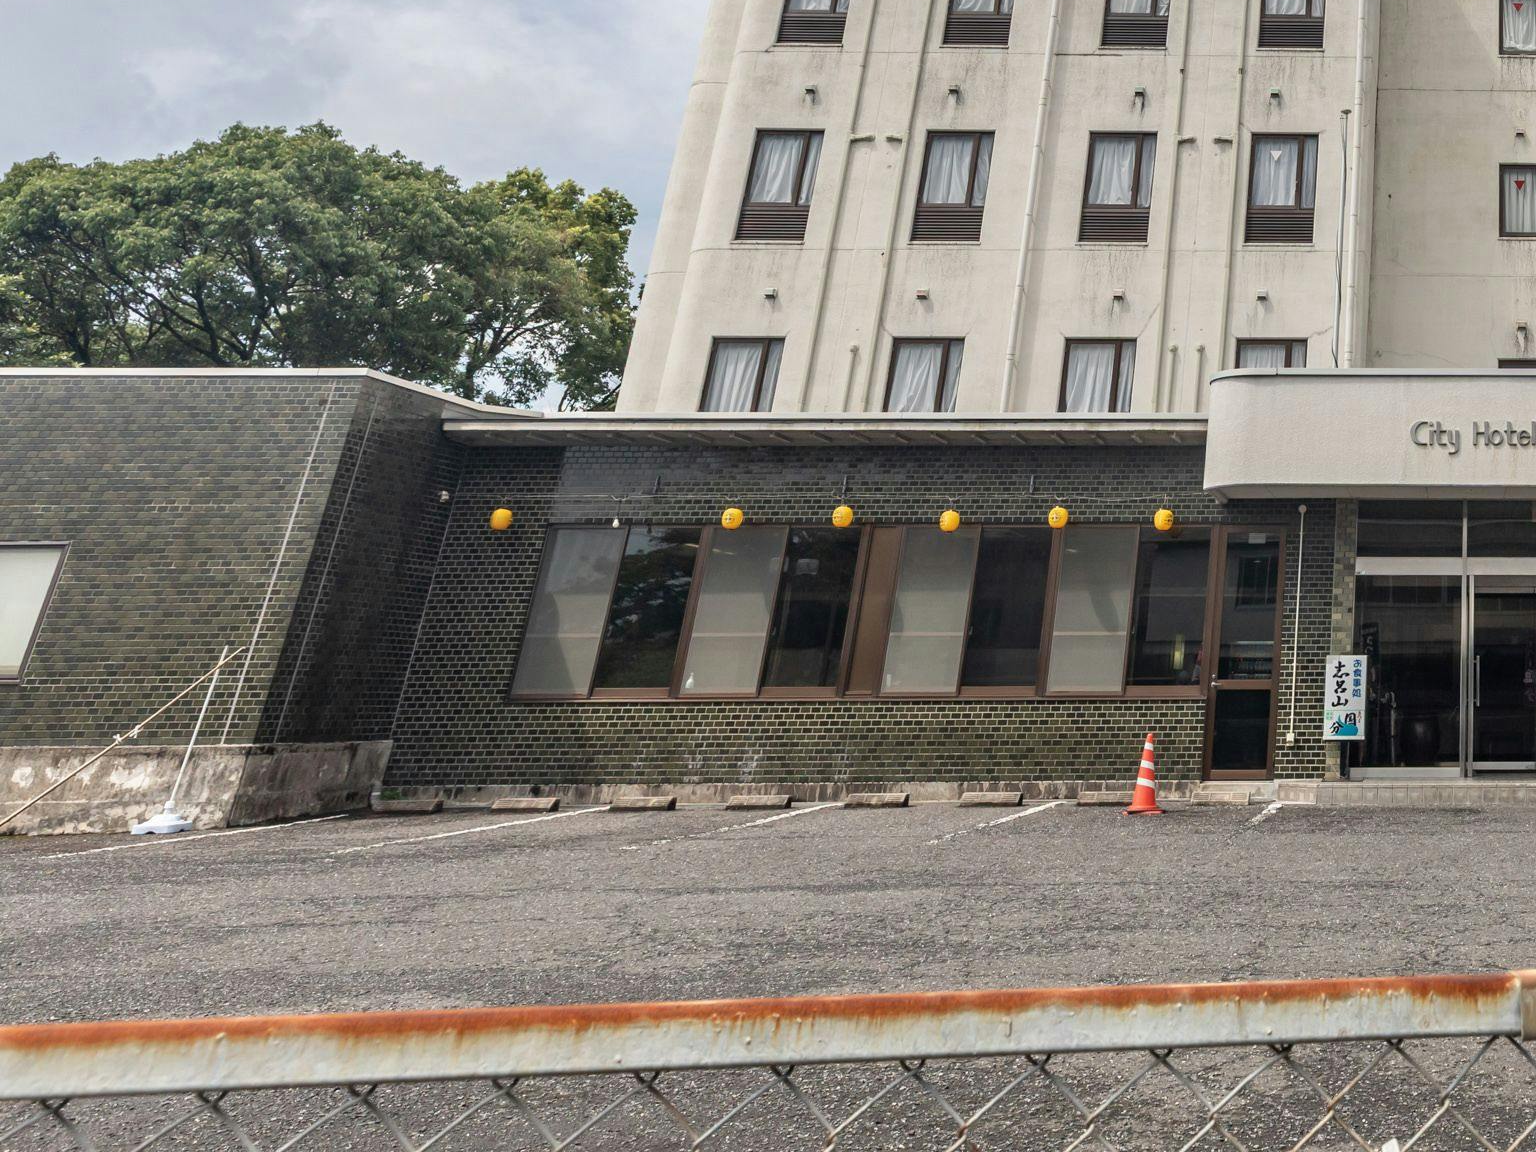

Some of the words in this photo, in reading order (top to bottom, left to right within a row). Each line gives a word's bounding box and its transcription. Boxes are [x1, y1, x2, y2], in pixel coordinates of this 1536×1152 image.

[1410, 420, 1461, 455] City
[1472, 420, 1536, 447] Hotel
[1352, 659, 1362, 698] お食事処
